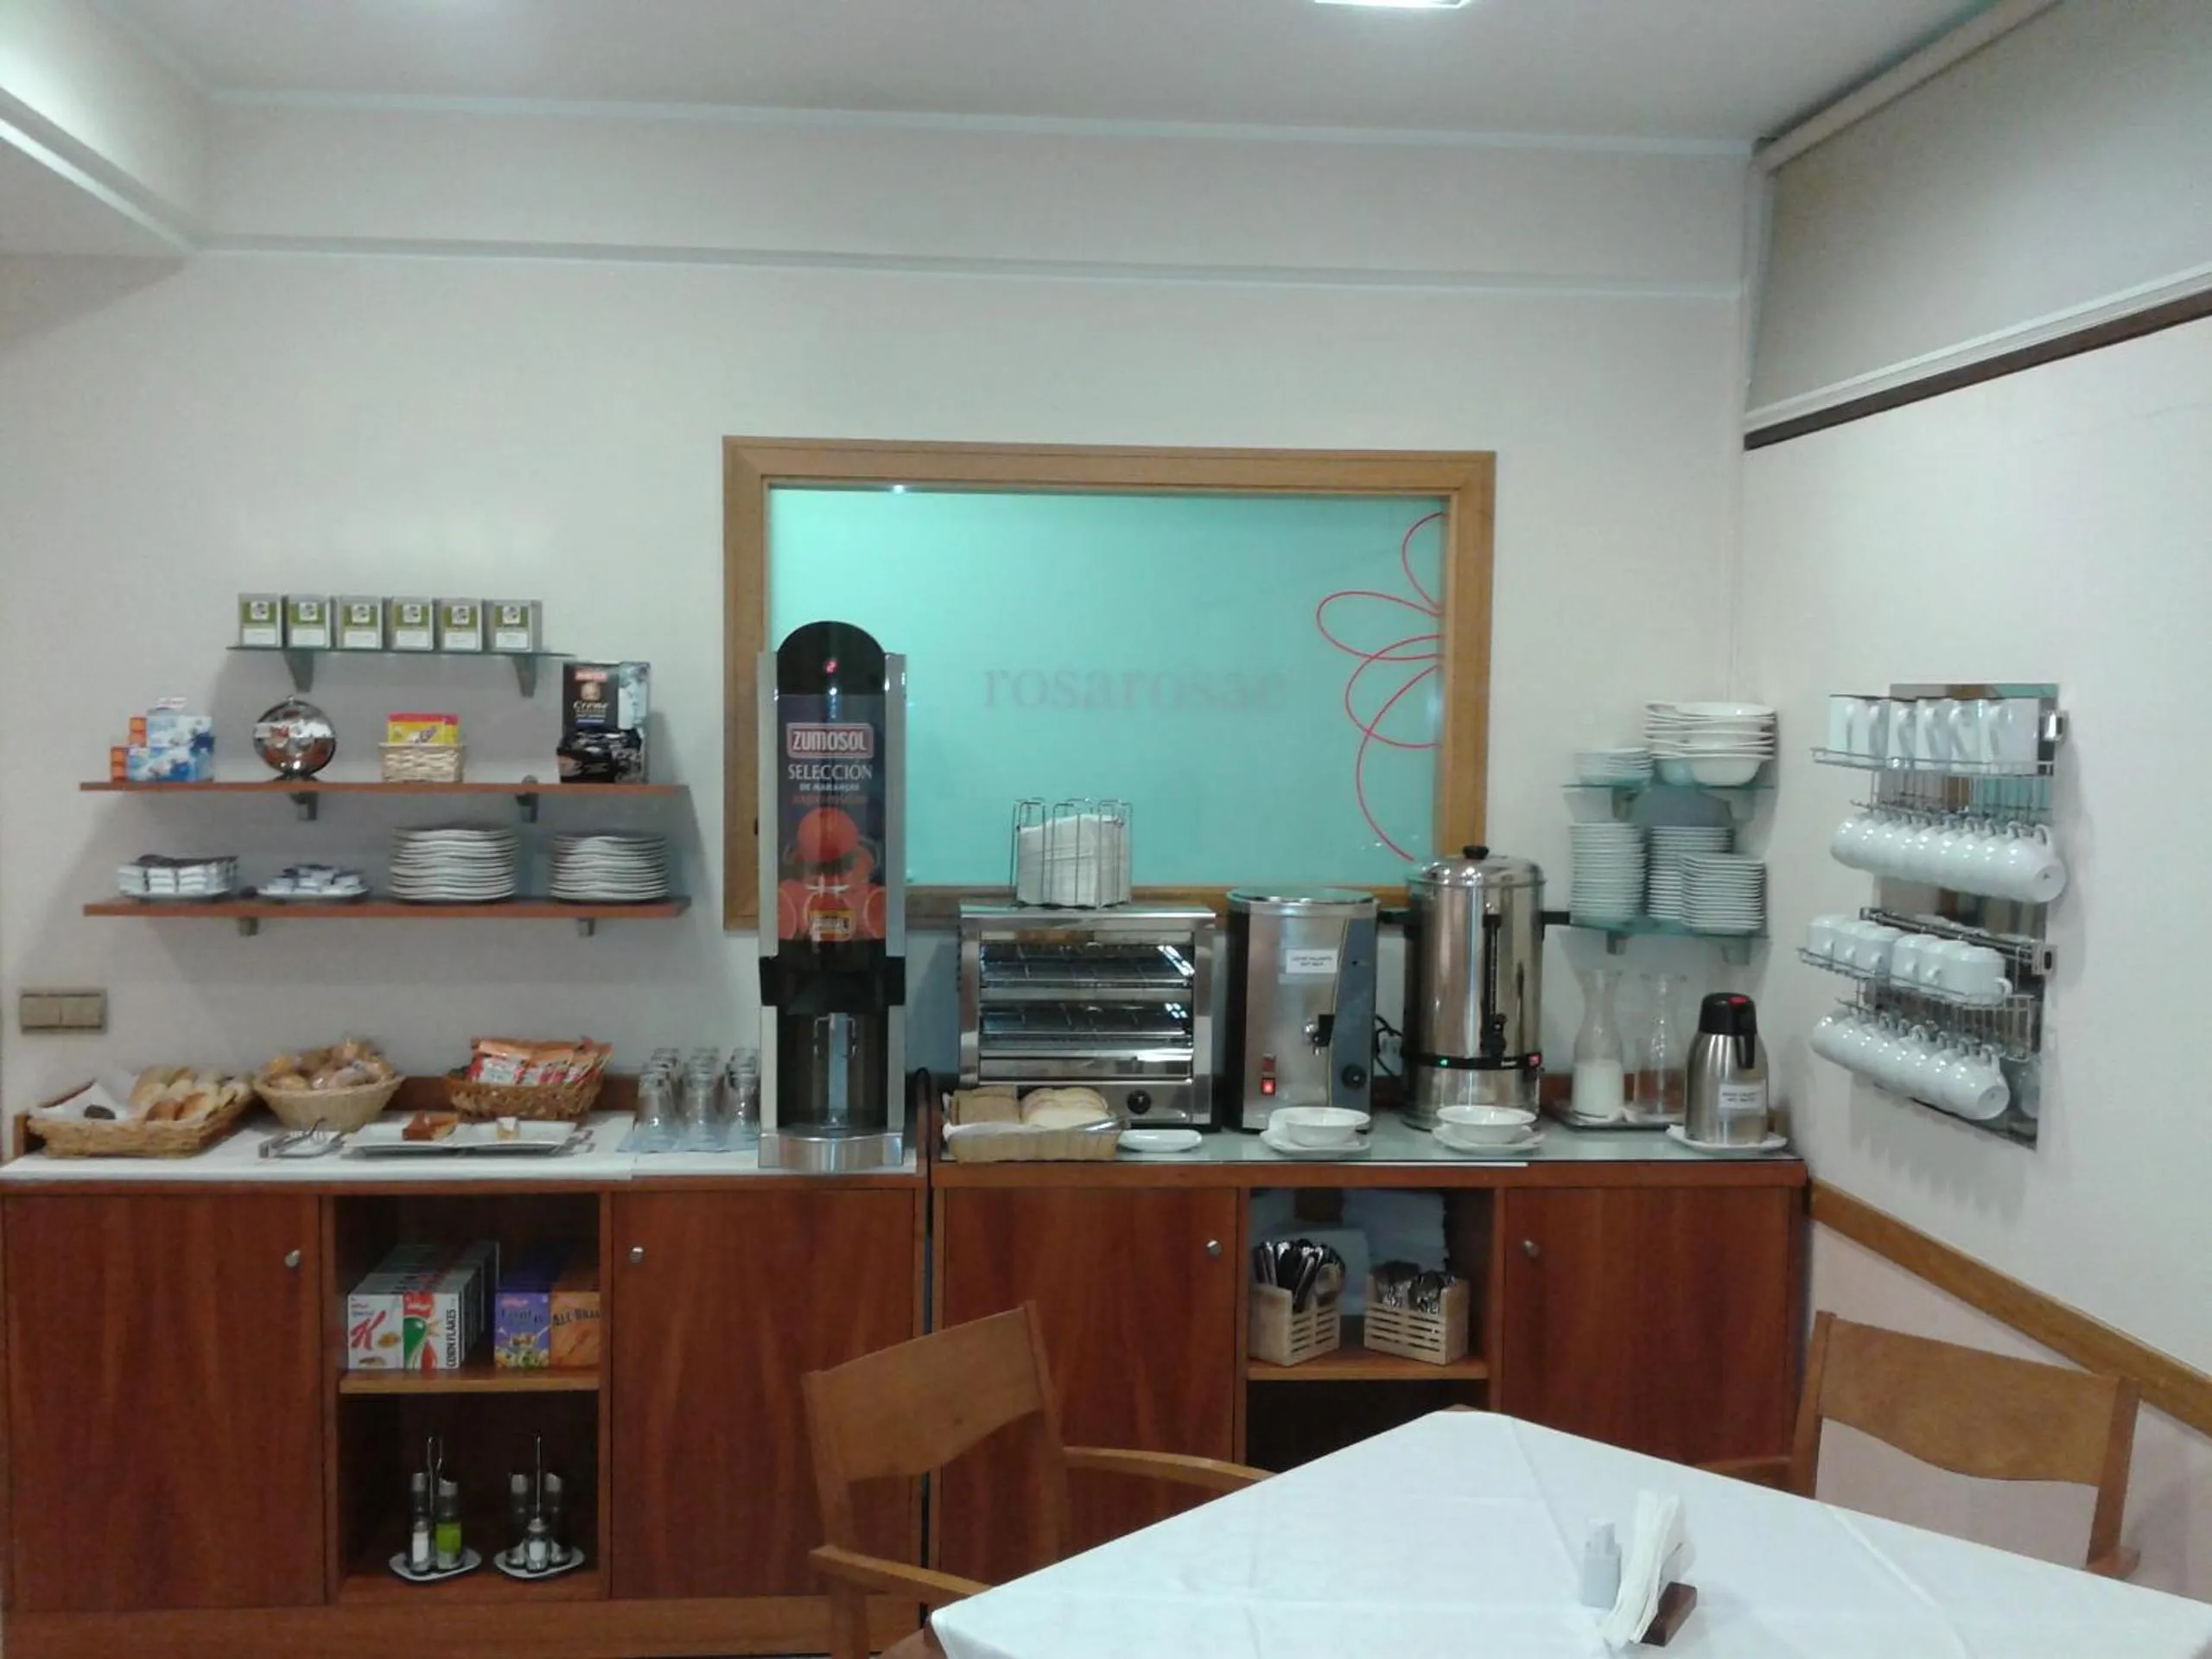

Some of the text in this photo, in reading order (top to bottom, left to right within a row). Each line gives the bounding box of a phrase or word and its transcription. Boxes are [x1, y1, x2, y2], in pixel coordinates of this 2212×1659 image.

[792, 731, 868, 751] ZUMOSOL
[788, 760, 873, 779] SELECCIÓN
[445, 1308, 457, 1367] CORN FLAKES
